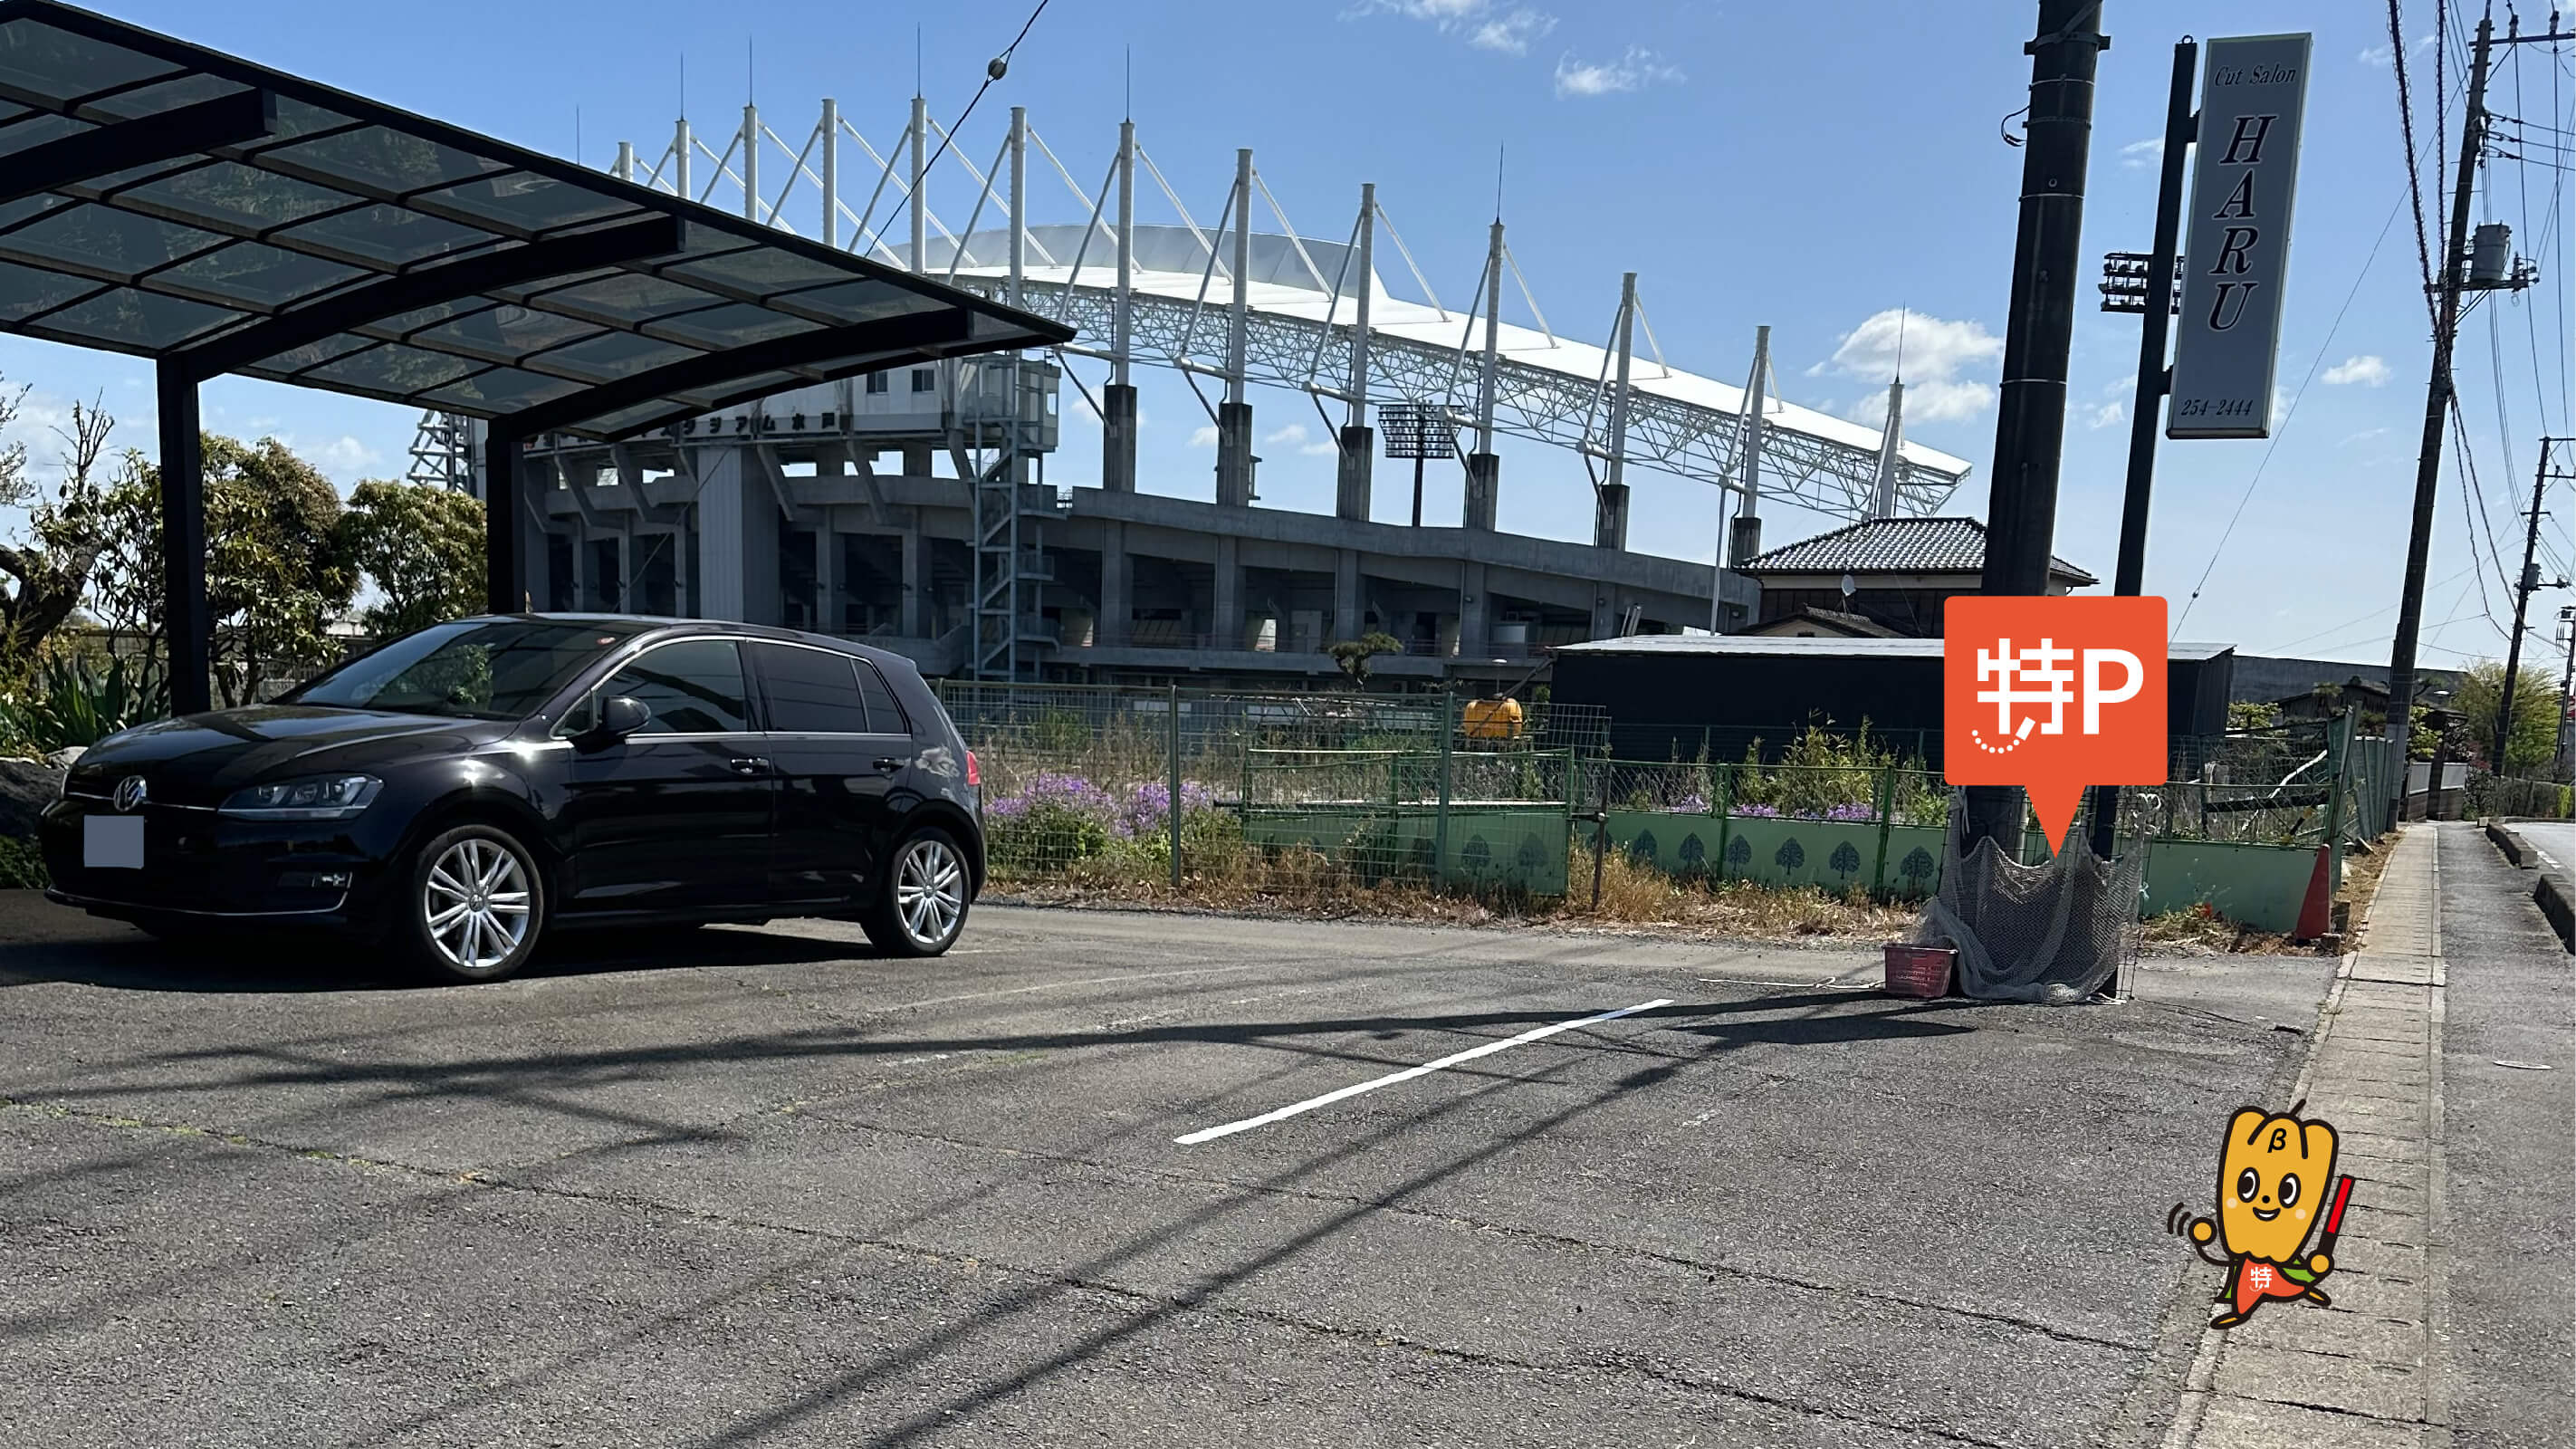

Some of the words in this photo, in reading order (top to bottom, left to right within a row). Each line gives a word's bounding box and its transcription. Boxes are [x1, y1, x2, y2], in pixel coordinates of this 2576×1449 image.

[2215, 66, 2244, 86] Cut
[2249, 63, 2296, 84] Salon
[2208, 114, 2277, 331] HARU
[2180, 399, 2253, 416] 254-2444
